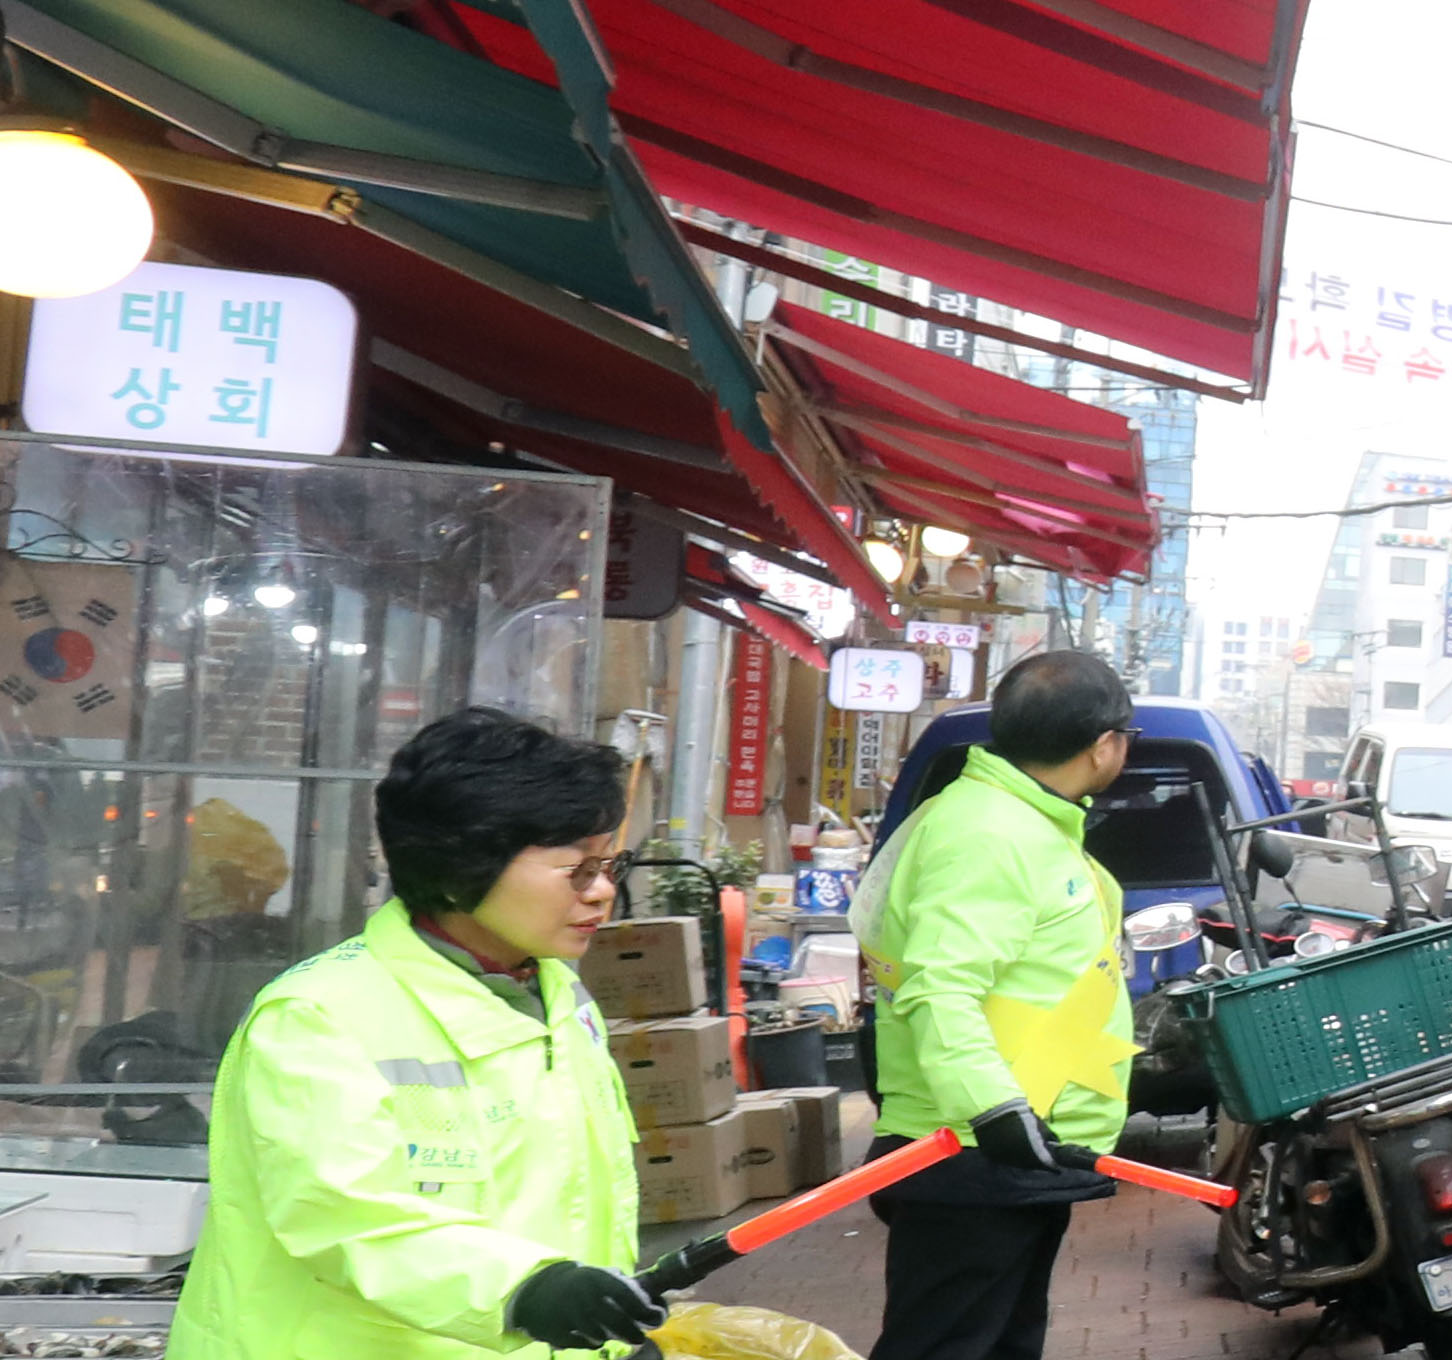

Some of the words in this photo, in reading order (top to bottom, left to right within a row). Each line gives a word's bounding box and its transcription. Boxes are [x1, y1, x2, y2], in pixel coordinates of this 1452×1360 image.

[119, 290, 283, 364] 태백
[110, 367, 274, 438] 상회
[853, 657, 903, 679] 상주
[421, 1147, 479, 1162] 강남구
